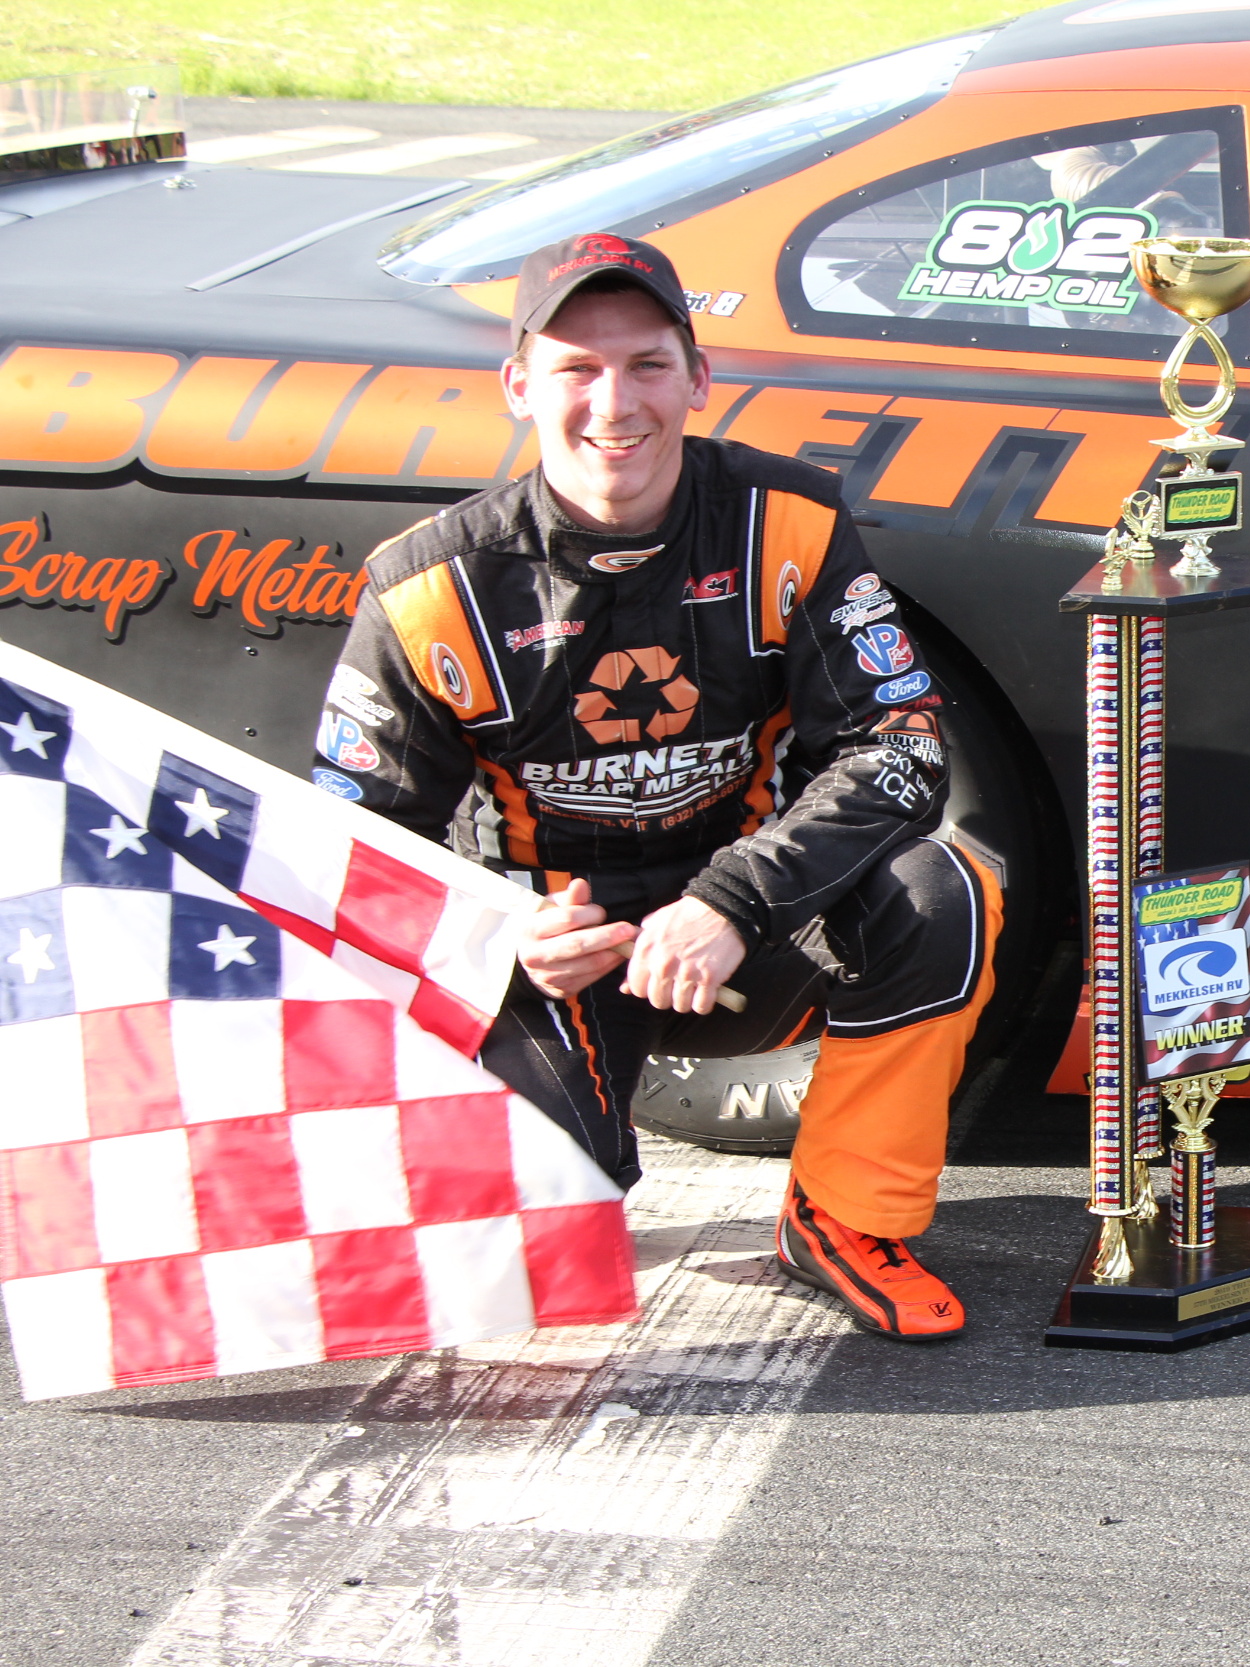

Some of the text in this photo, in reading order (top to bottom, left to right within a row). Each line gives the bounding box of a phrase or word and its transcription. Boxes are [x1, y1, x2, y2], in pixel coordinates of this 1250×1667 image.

[908, 268, 1130, 308] HEMP OIL
[0, 345, 1224, 528] BURETT
[513, 620, 586, 653] AMERICAN
[888, 675, 923, 700] Ford
[526, 782, 633, 795] SCRAP
[873, 766, 919, 810] ICE
[660, 810, 695, 831] (802)
[1145, 884, 1235, 911] THUNDER ROAD
[1154, 979, 1243, 1005] MEKKELSEN RV
[1155, 1014, 1246, 1052] WINNER
